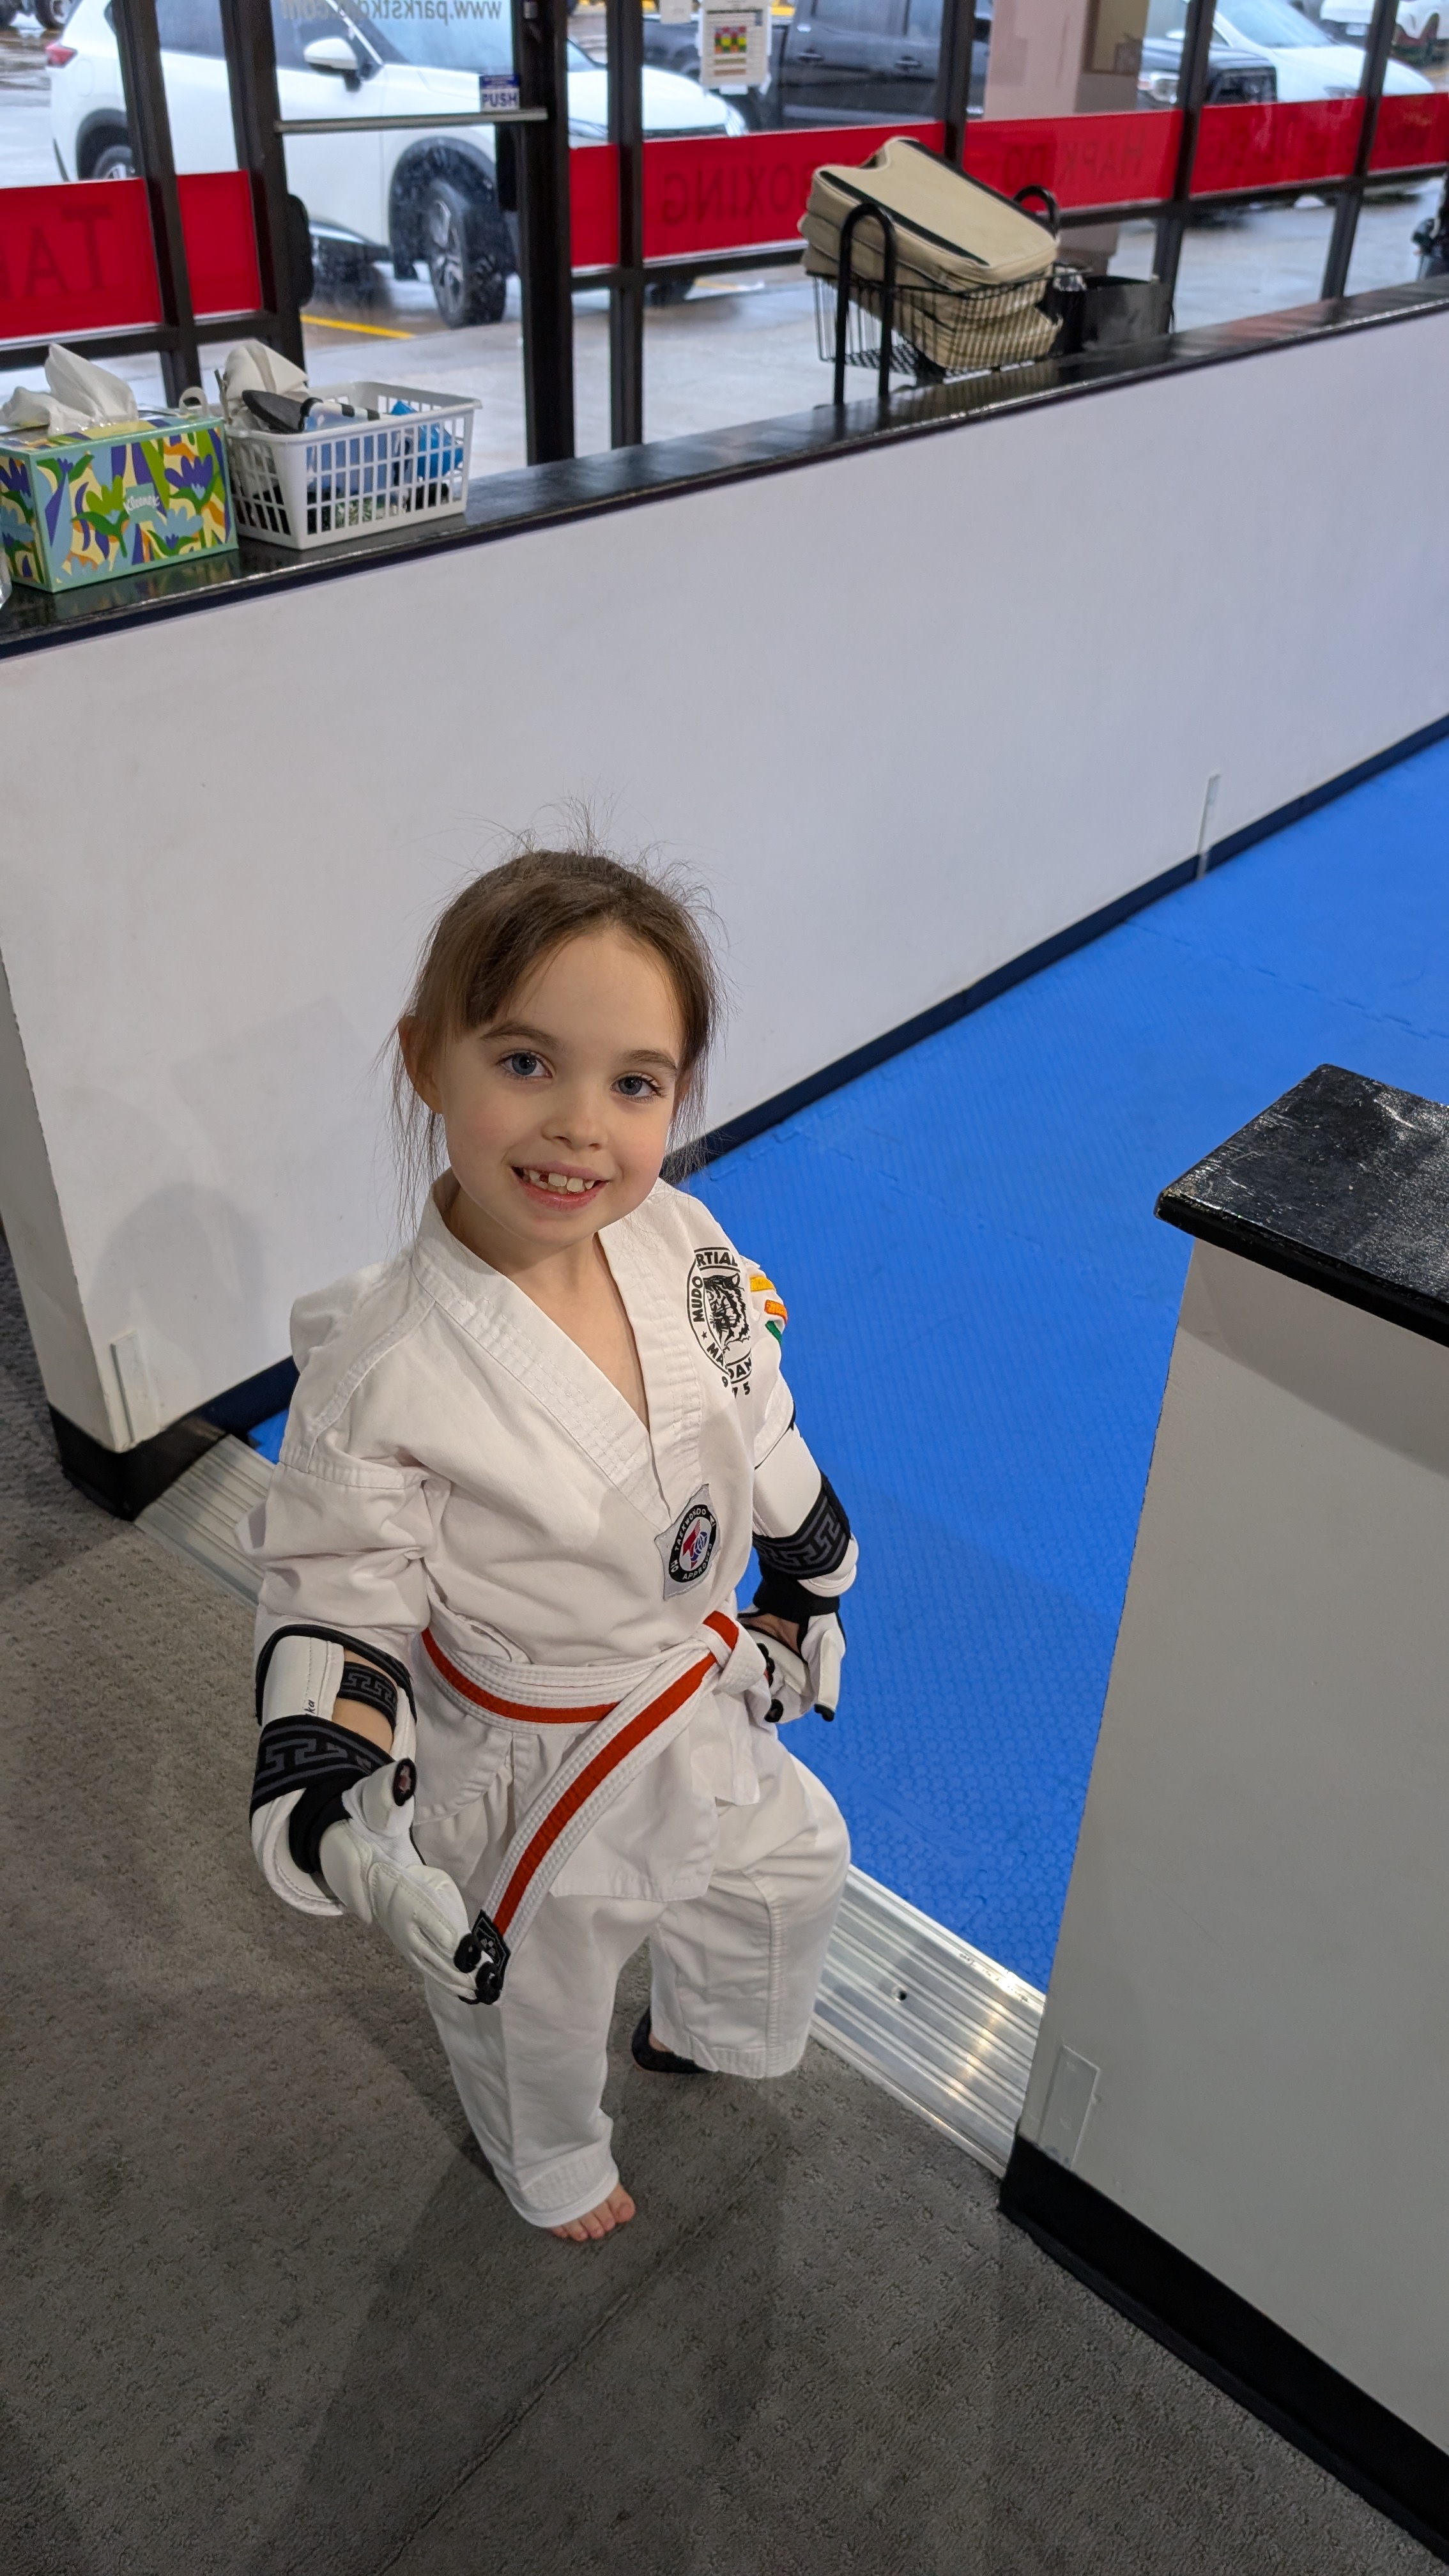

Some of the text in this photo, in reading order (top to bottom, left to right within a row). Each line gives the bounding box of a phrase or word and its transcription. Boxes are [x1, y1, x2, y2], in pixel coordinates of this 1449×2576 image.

[482, 93, 518, 108] PUSH
[123, 495, 160, 516] Kleenex
[691, 1250, 739, 1322] MUDO RTIAL
[674, 1507, 707, 1551] TAEKWONDO
[682, 1542, 712, 1580] APPROVED
